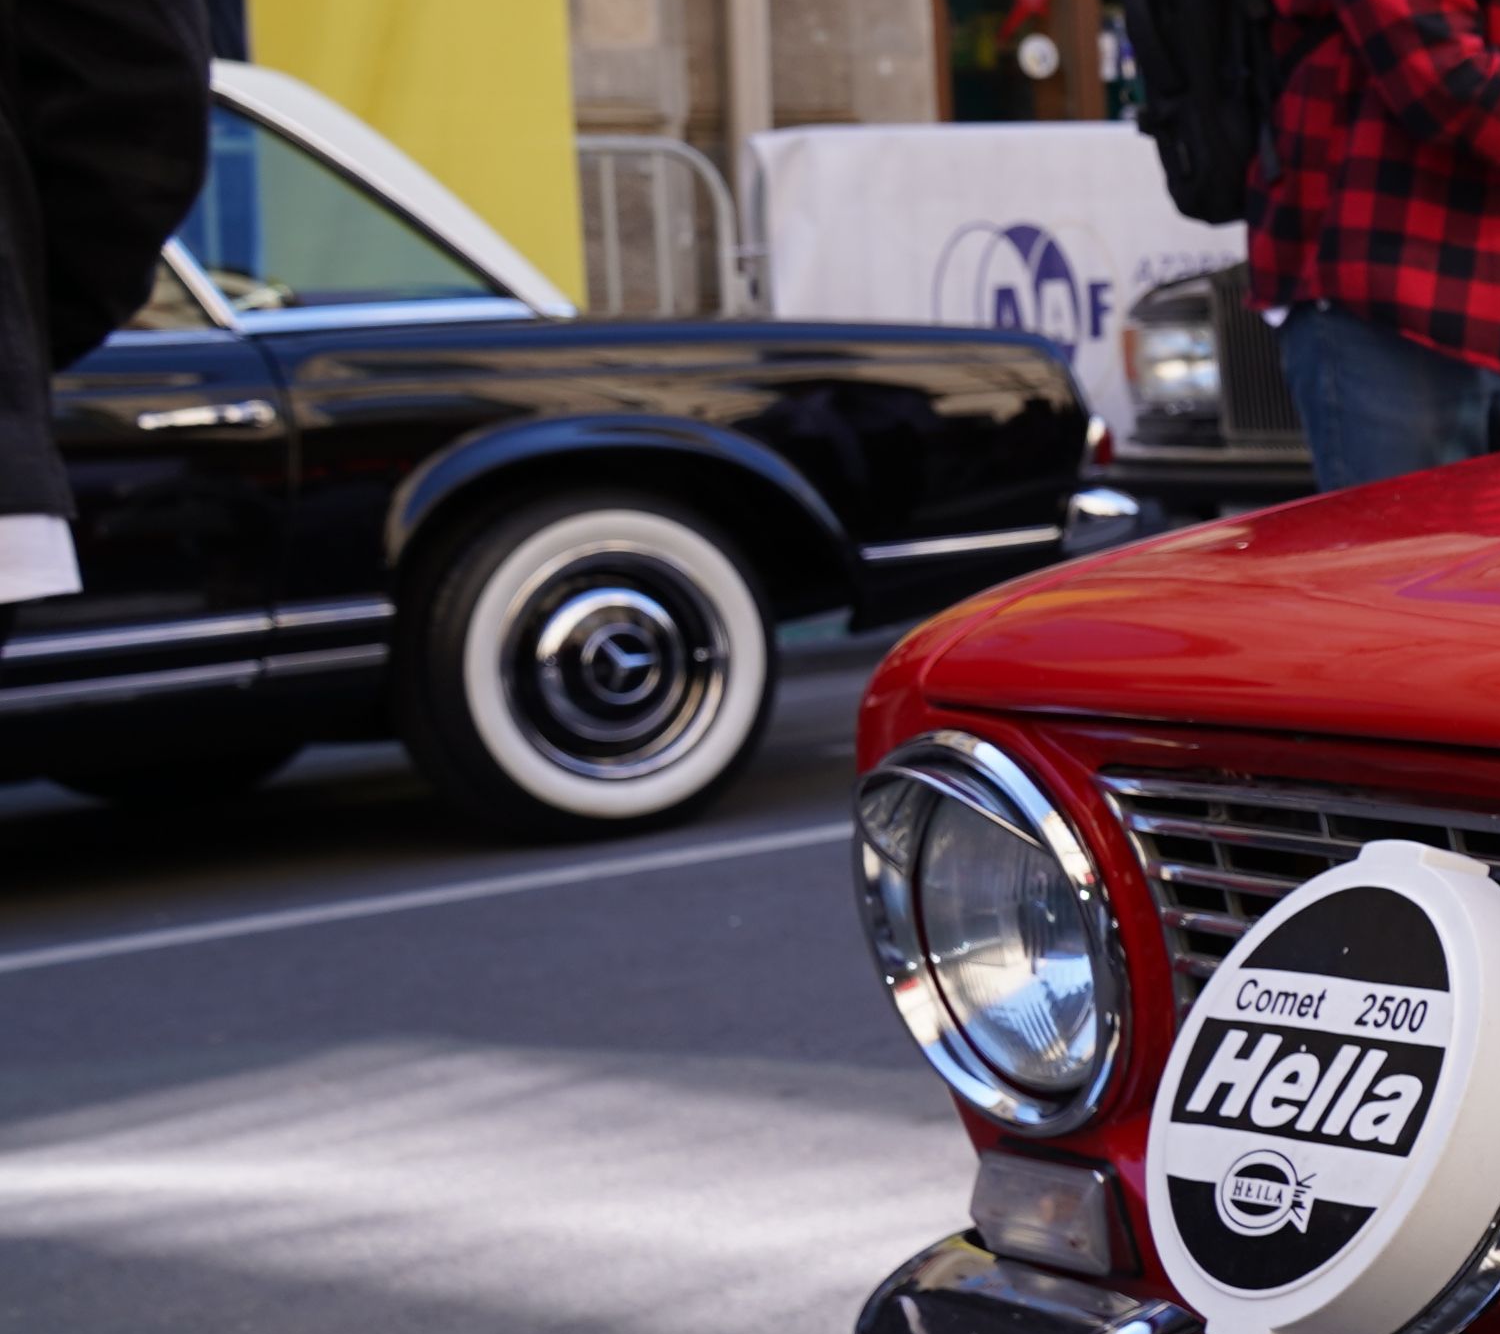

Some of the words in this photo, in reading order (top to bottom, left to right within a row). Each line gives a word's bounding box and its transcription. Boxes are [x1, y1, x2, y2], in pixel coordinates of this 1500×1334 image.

[1236, 978, 1328, 1020] Comet
[1354, 993, 1429, 1033] 2500
[1186, 1028, 1424, 1148] Hella
